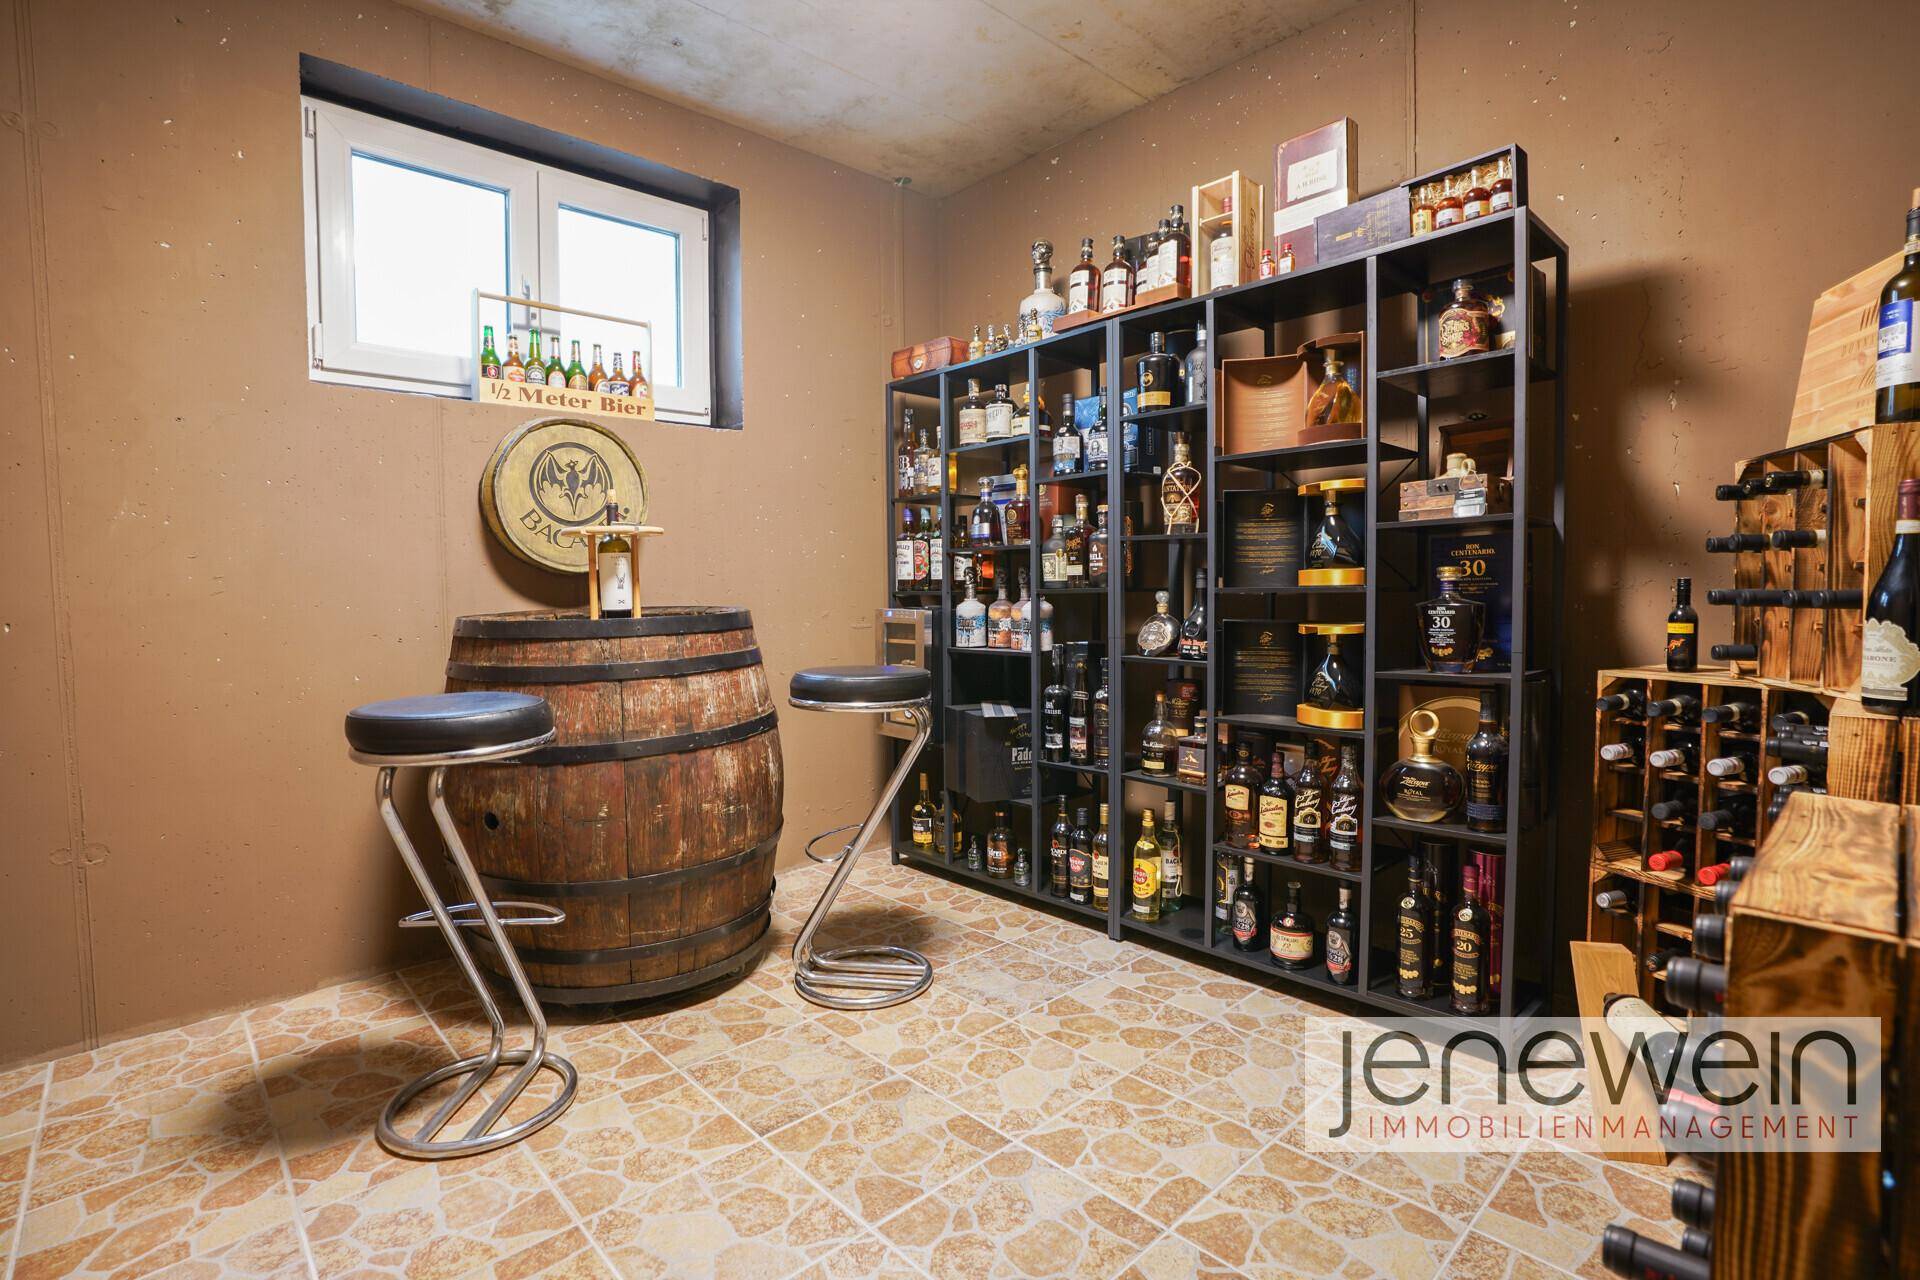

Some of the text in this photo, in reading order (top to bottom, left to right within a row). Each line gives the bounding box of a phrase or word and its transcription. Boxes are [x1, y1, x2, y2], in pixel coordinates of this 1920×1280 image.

[519, 386, 593, 409] Meter
[600, 396, 647, 416] Bier
[1460, 559, 1486, 577] 30
[1432, 616, 1451, 629] 30
[1400, 927, 1414, 939] 25
[1456, 940, 1473, 953] 20
